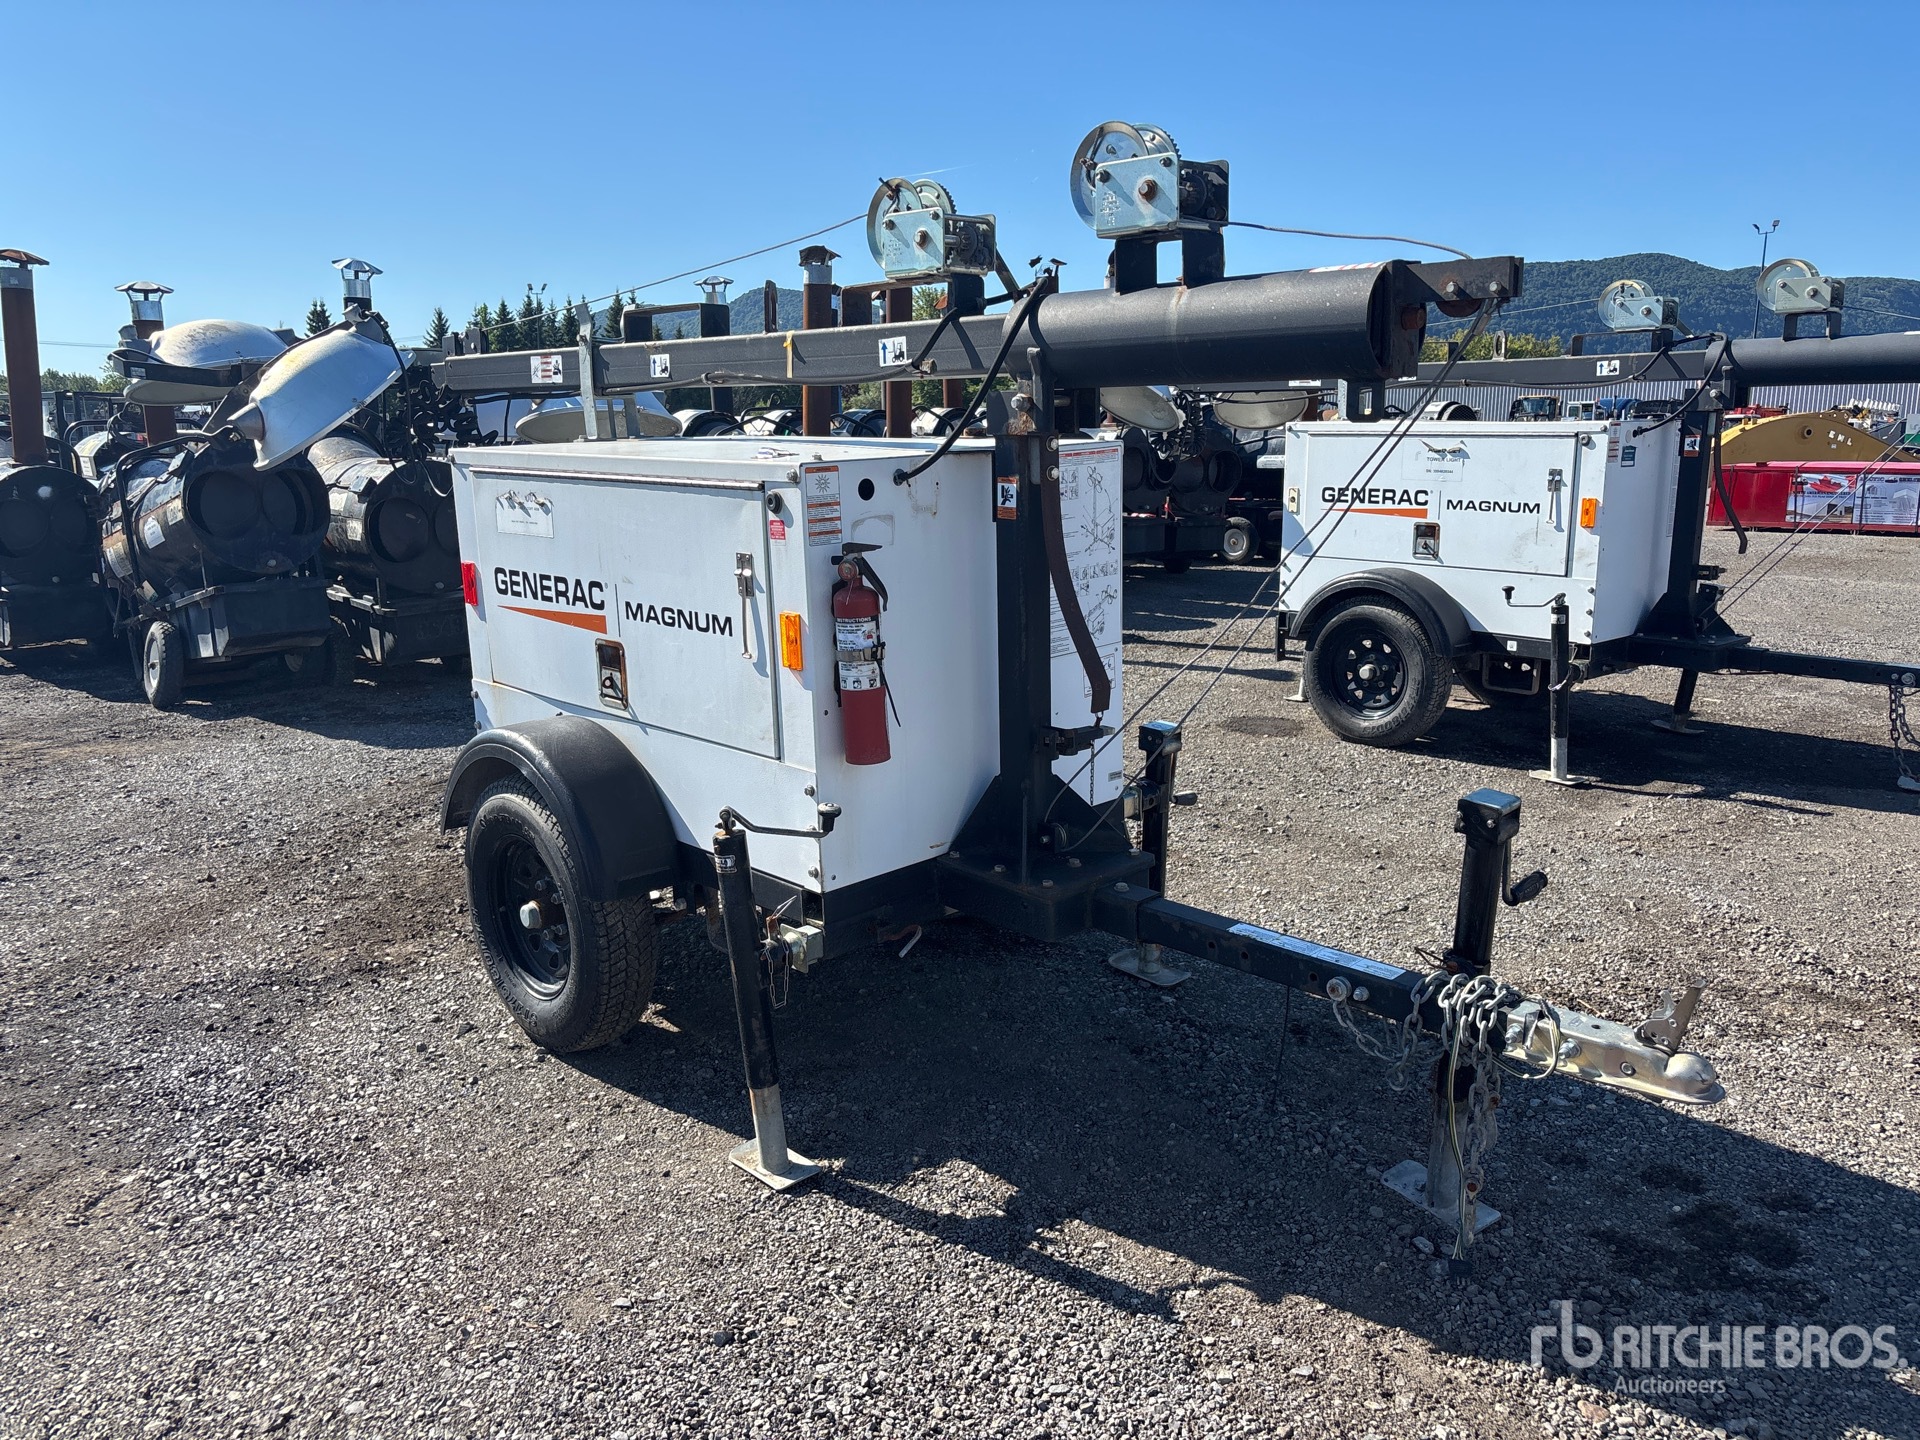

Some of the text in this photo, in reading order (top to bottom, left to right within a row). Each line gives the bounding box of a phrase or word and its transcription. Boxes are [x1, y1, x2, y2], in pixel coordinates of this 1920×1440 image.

[1321, 486, 1541, 514] GENERAC MAGNUM
[494, 566, 734, 638] GENERAC MAGNUM
